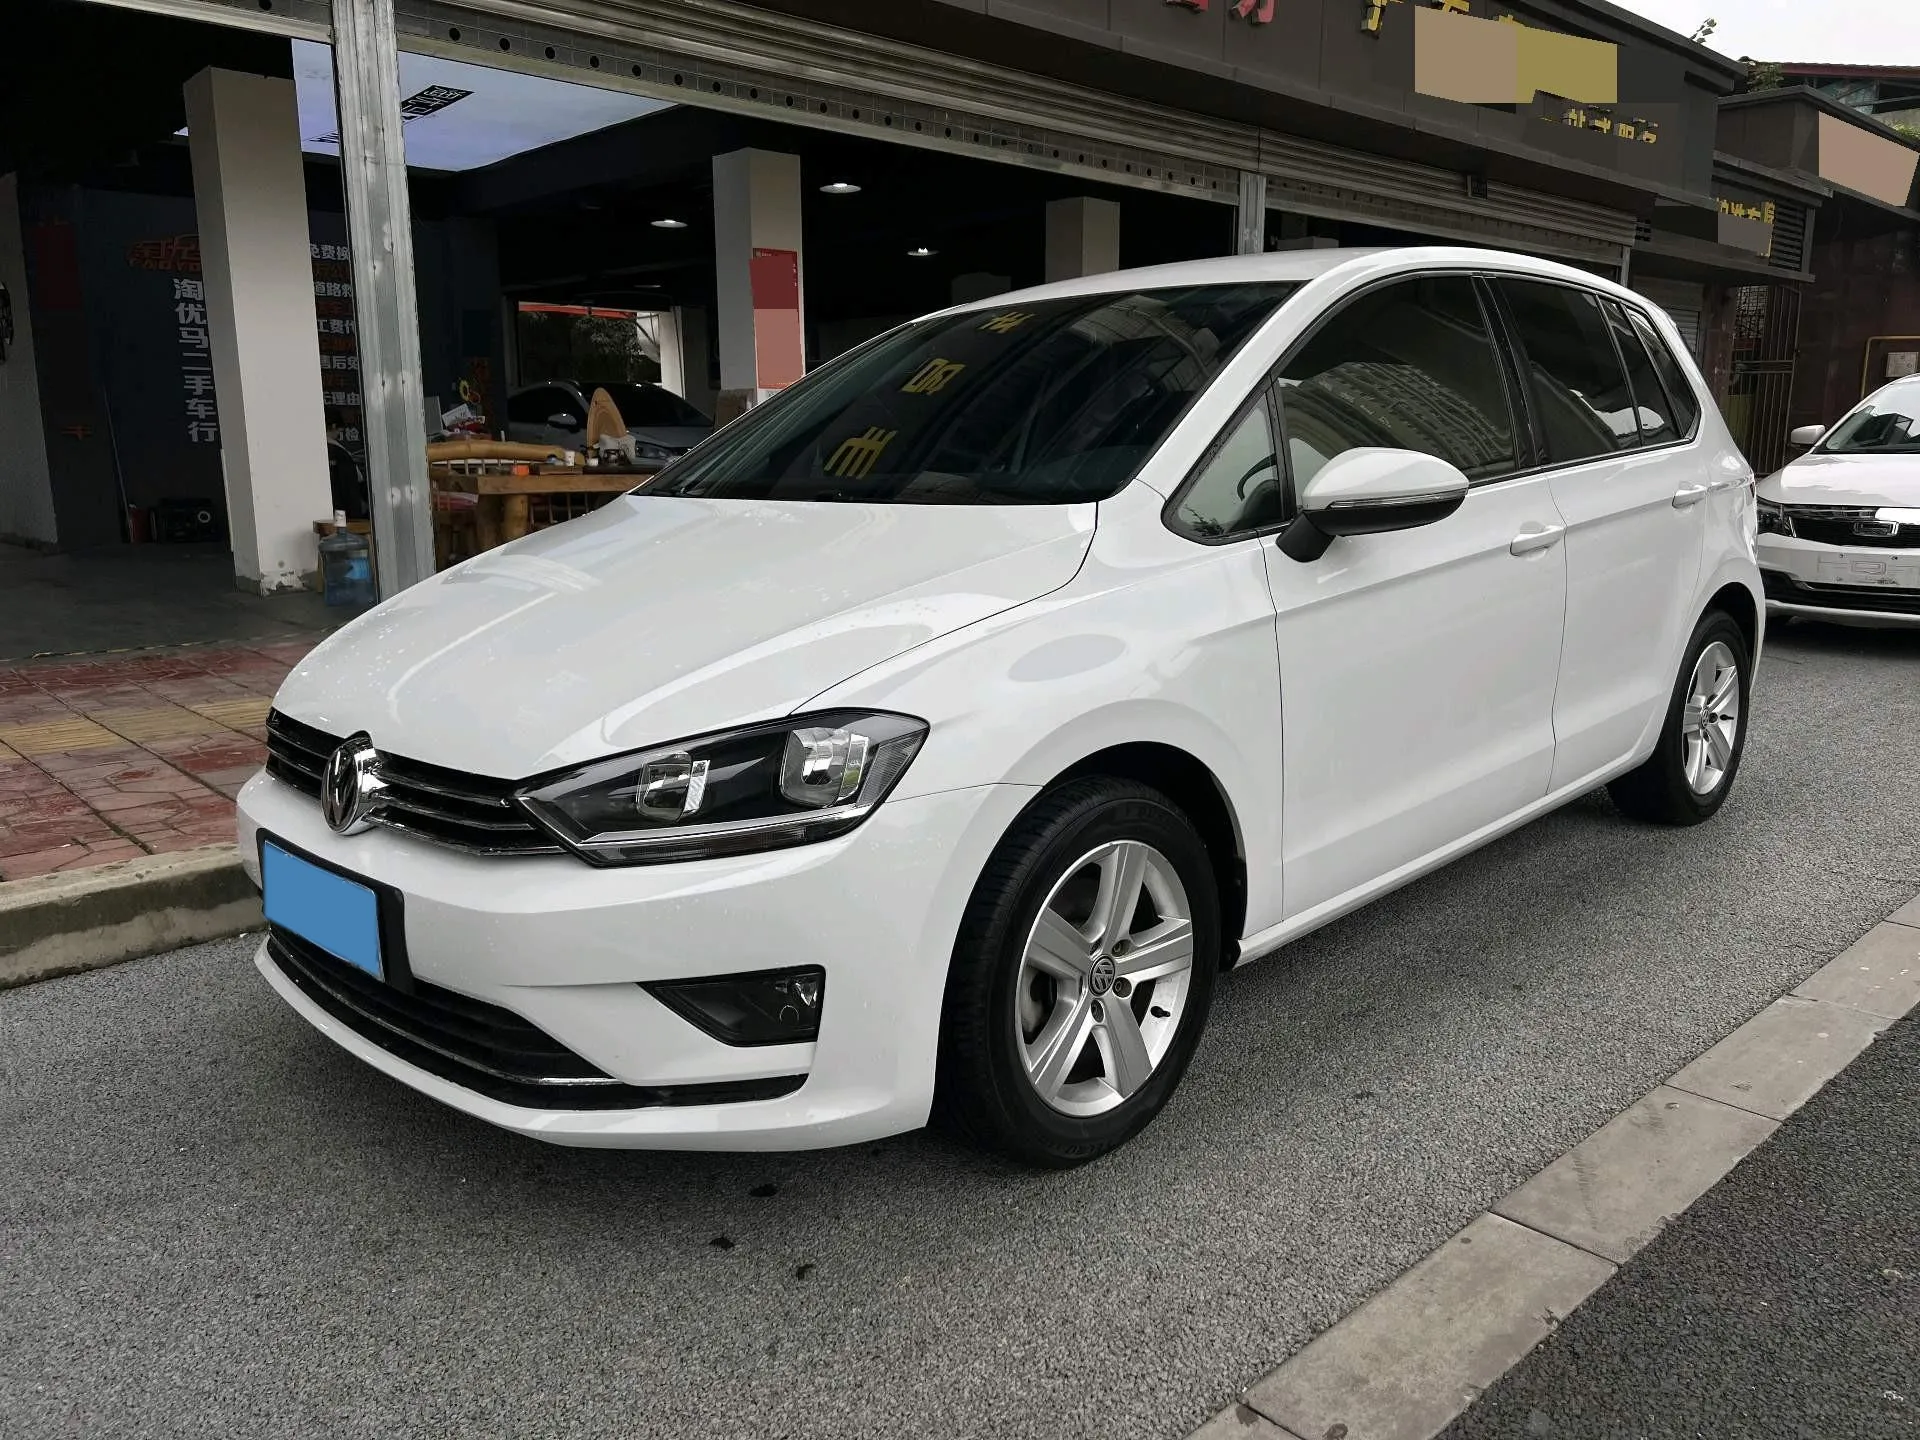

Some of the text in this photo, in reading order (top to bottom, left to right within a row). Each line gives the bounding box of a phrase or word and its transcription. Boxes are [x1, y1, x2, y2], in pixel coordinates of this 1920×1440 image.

[173, 278, 218, 443] 淘优马二手车行
